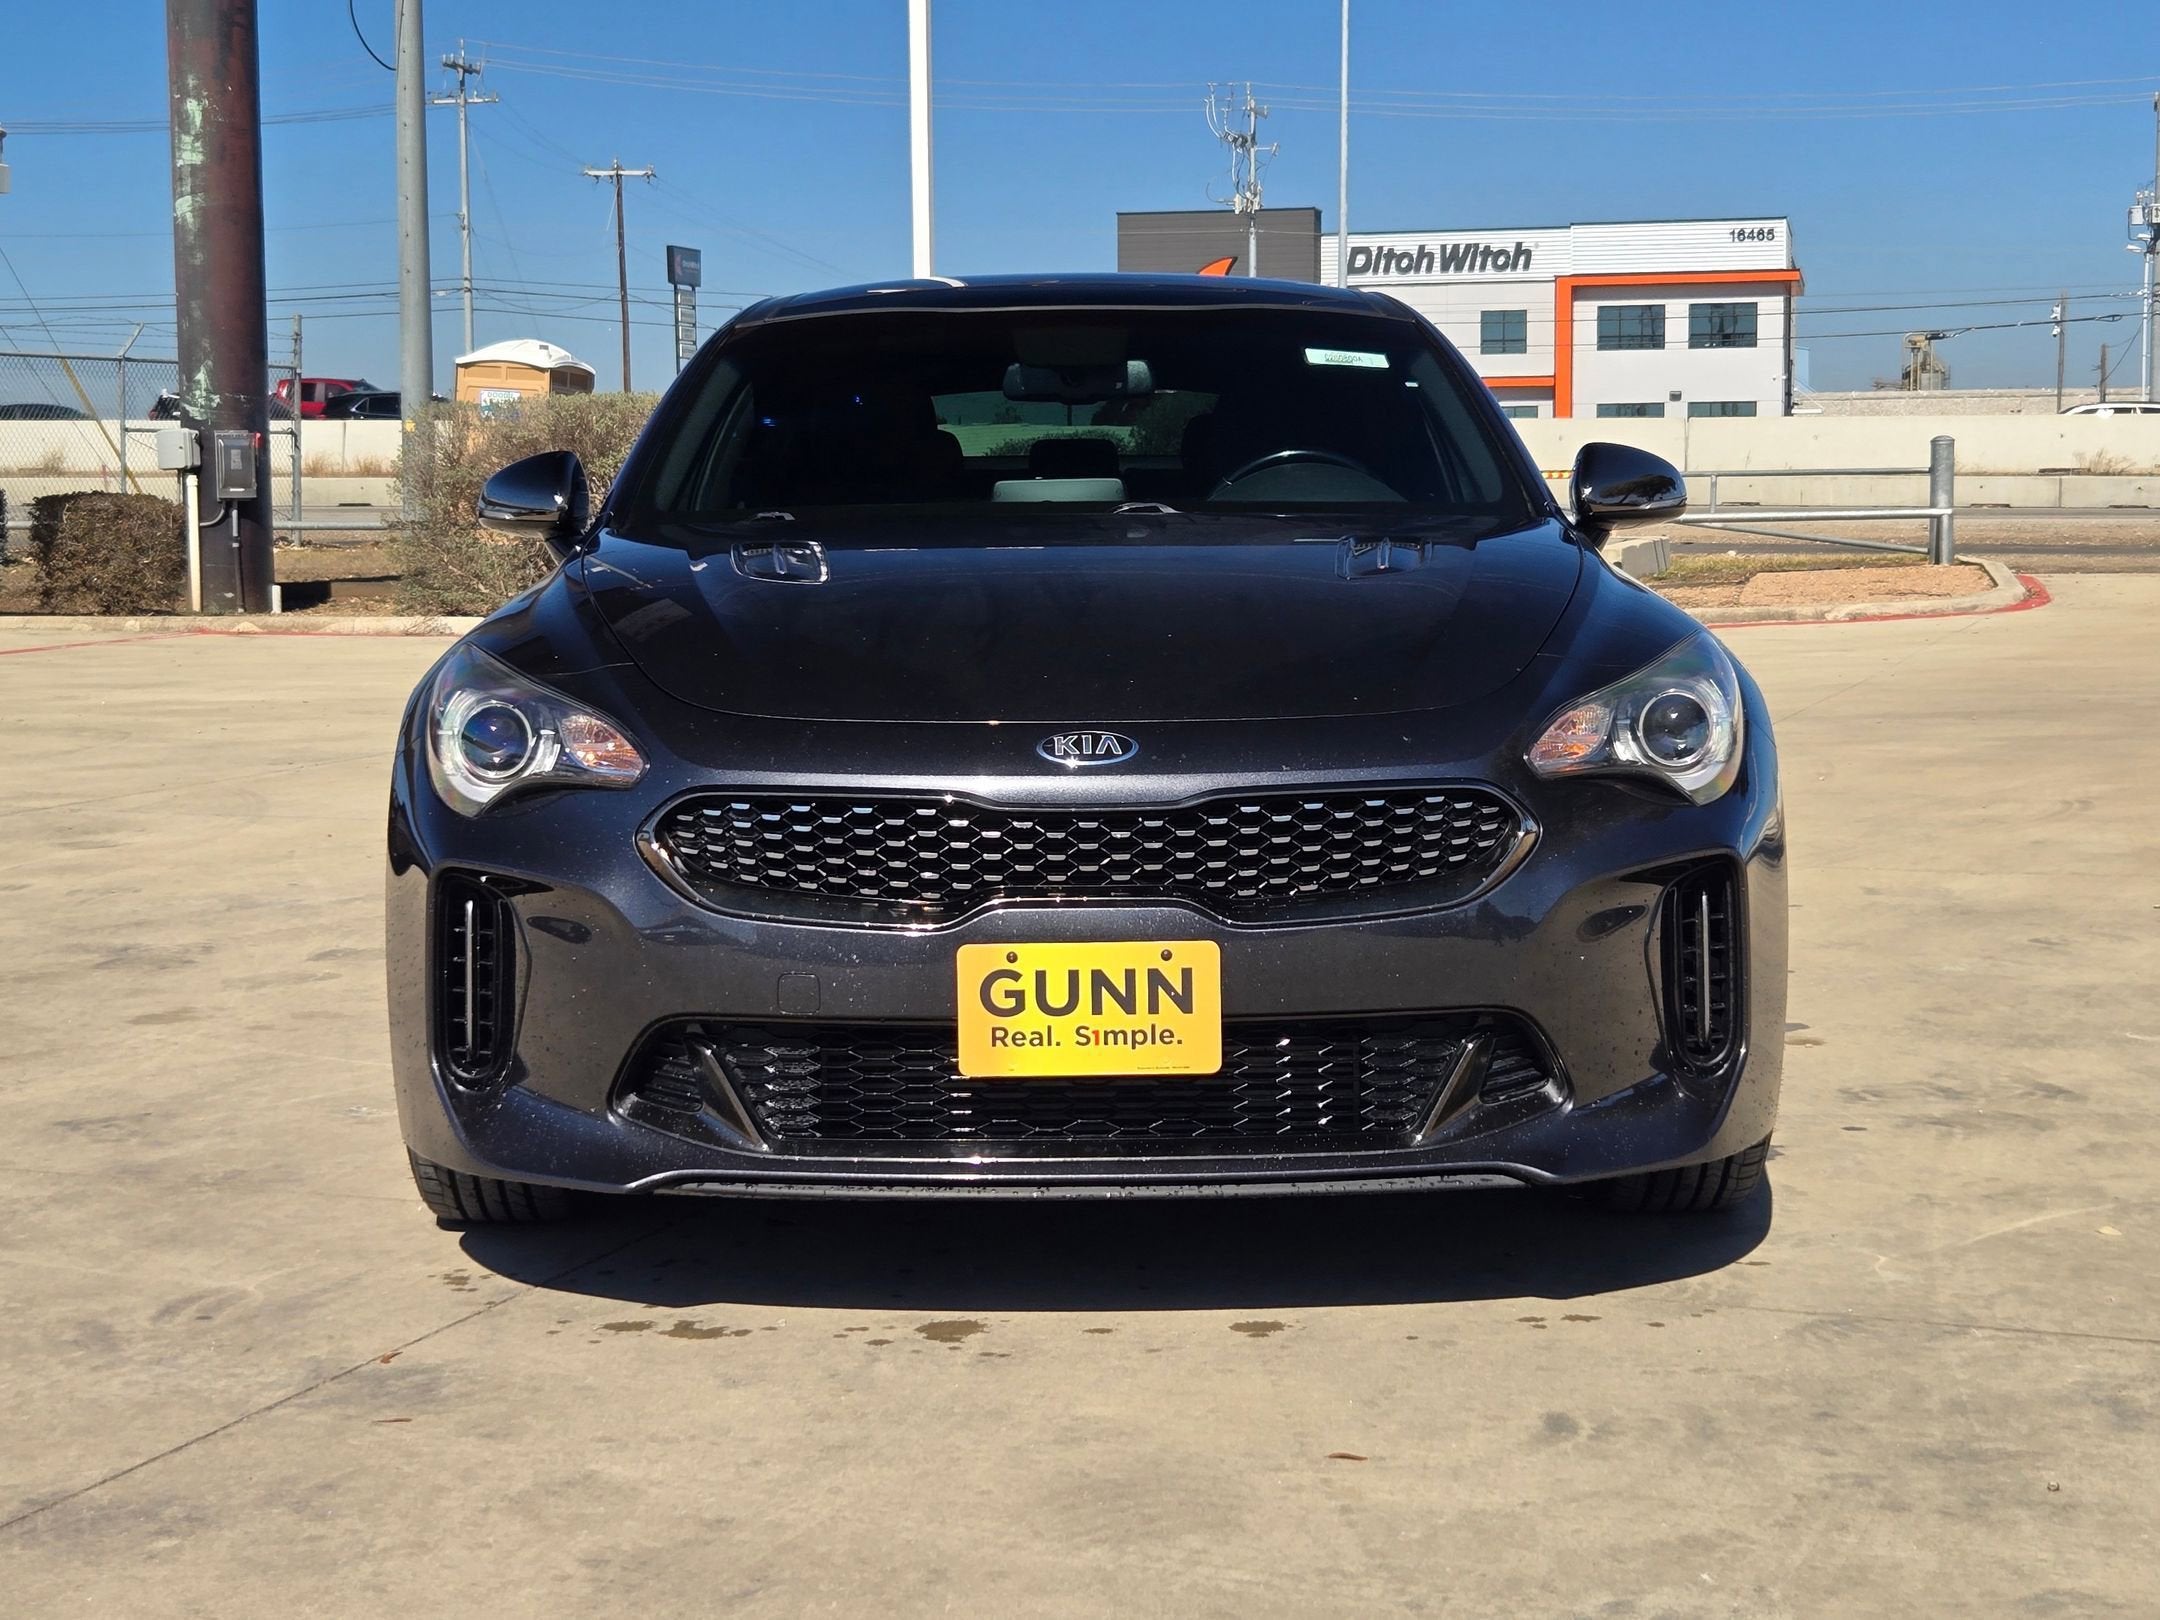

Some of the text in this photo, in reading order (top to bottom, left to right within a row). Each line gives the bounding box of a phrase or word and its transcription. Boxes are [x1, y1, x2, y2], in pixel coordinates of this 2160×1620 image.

[1053, 734, 1123, 756] KIA
[979, 967, 1194, 1018] GUNN
[991, 1025, 1062, 1048] Real.
